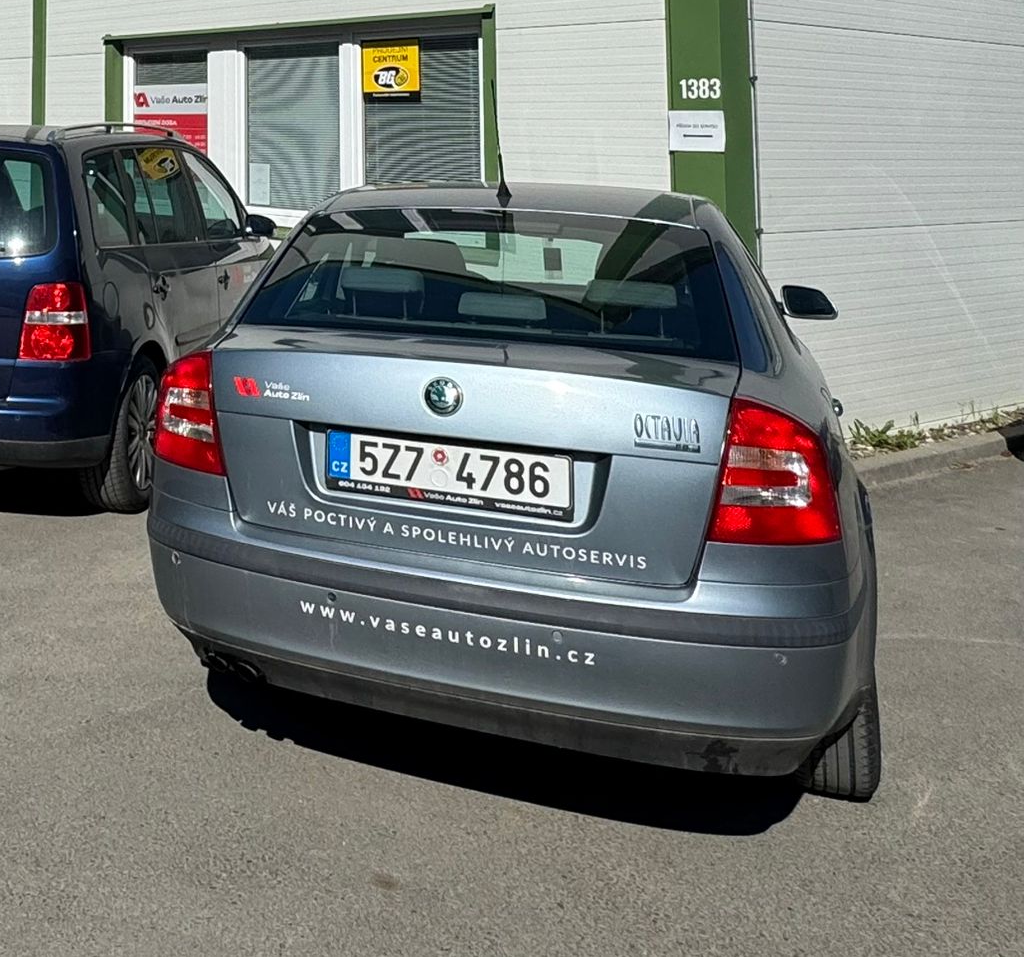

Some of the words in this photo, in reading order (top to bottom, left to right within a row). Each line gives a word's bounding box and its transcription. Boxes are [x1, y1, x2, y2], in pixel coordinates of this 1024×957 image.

[372, 54, 409, 63] CENTRUM
[375, 70, 397, 85] BG
[679, 77, 721, 100] 1383
[172, 95, 193, 104] Auto
[263, 389, 290, 399] Auto
[332, 460, 348, 473] CZ
[359, 440, 424, 482] 5Z7
[456, 452, 550, 499] 4786
[445, 494, 467, 504] Auto
[267, 500, 297, 518] VÁŠ
[303, 508, 378, 533] POCTIVÝ
[383, 521, 394, 535] A
[401, 524, 515, 553] SPOLEHLIVÝ
[522, 542, 648, 570] AUTOSERVIS
[300, 599, 596, 666] www.vaseautozlin.cz
